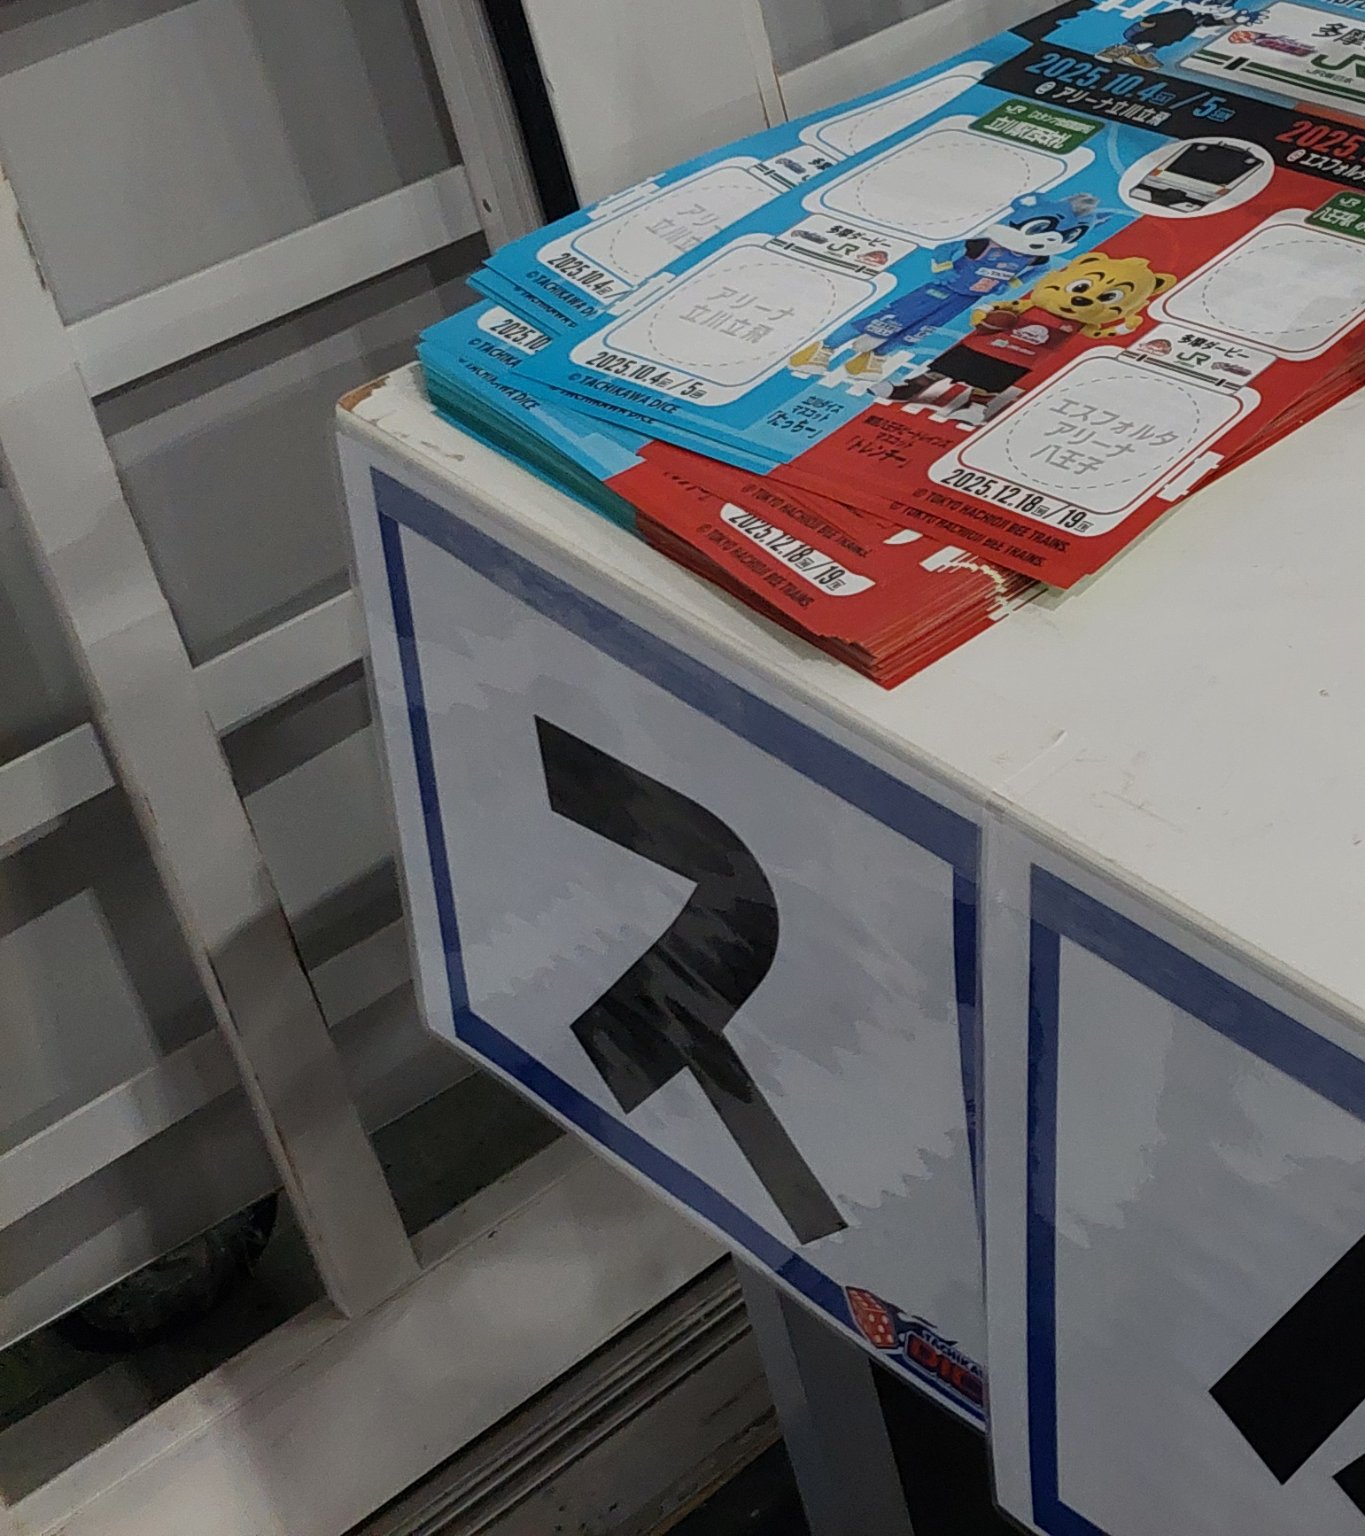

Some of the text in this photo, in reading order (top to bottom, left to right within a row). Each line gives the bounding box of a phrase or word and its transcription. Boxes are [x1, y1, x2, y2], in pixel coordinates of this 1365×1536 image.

[706, 286, 797, 321] アリーナ
[678, 304, 777, 345] 立川立飛
[1176, 350, 1211, 366] JR
[1043, 421, 1137, 458] アリーナ
[1049, 397, 1181, 449] エスフォルタ
[1029, 443, 1111, 477] 八王子
[533, 715, 850, 1245] ス
